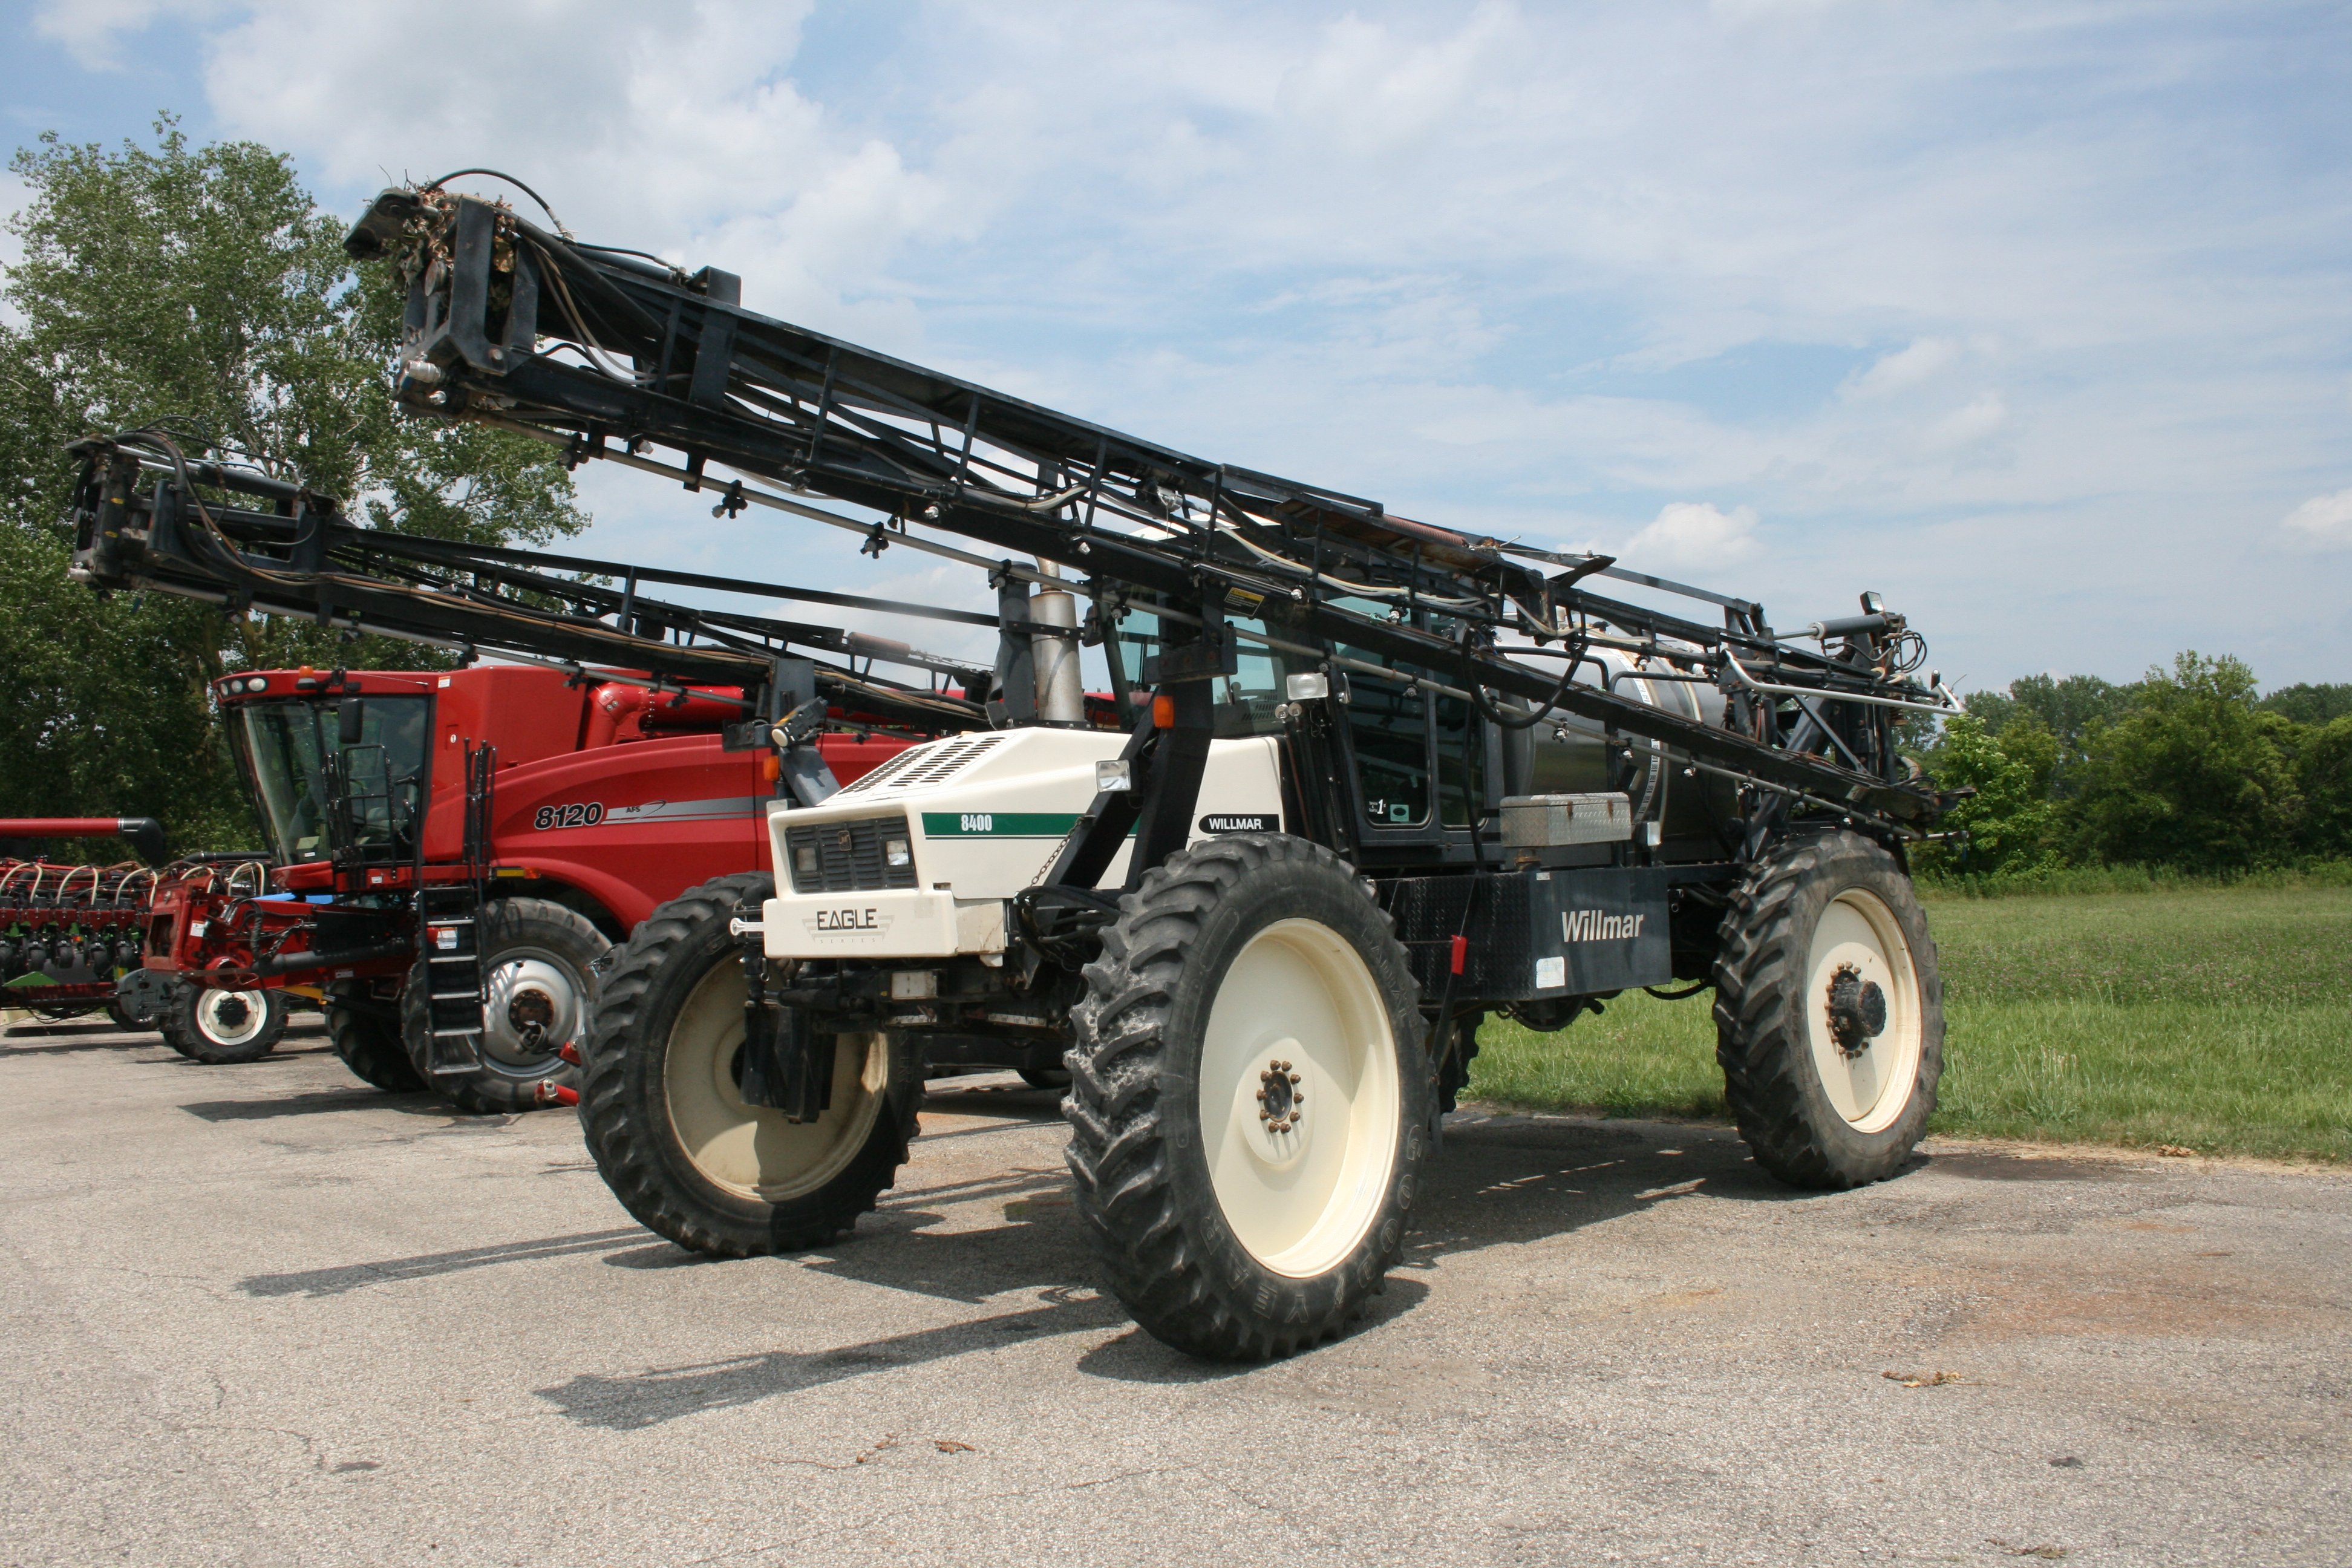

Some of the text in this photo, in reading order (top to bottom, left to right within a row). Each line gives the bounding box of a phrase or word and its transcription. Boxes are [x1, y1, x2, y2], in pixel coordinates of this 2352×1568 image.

[534, 802, 604, 830] 8120
[961, 814, 993, 831] 8400
[817, 908, 878, 930] EAGLE
[1561, 909, 1644, 942] Willmar
